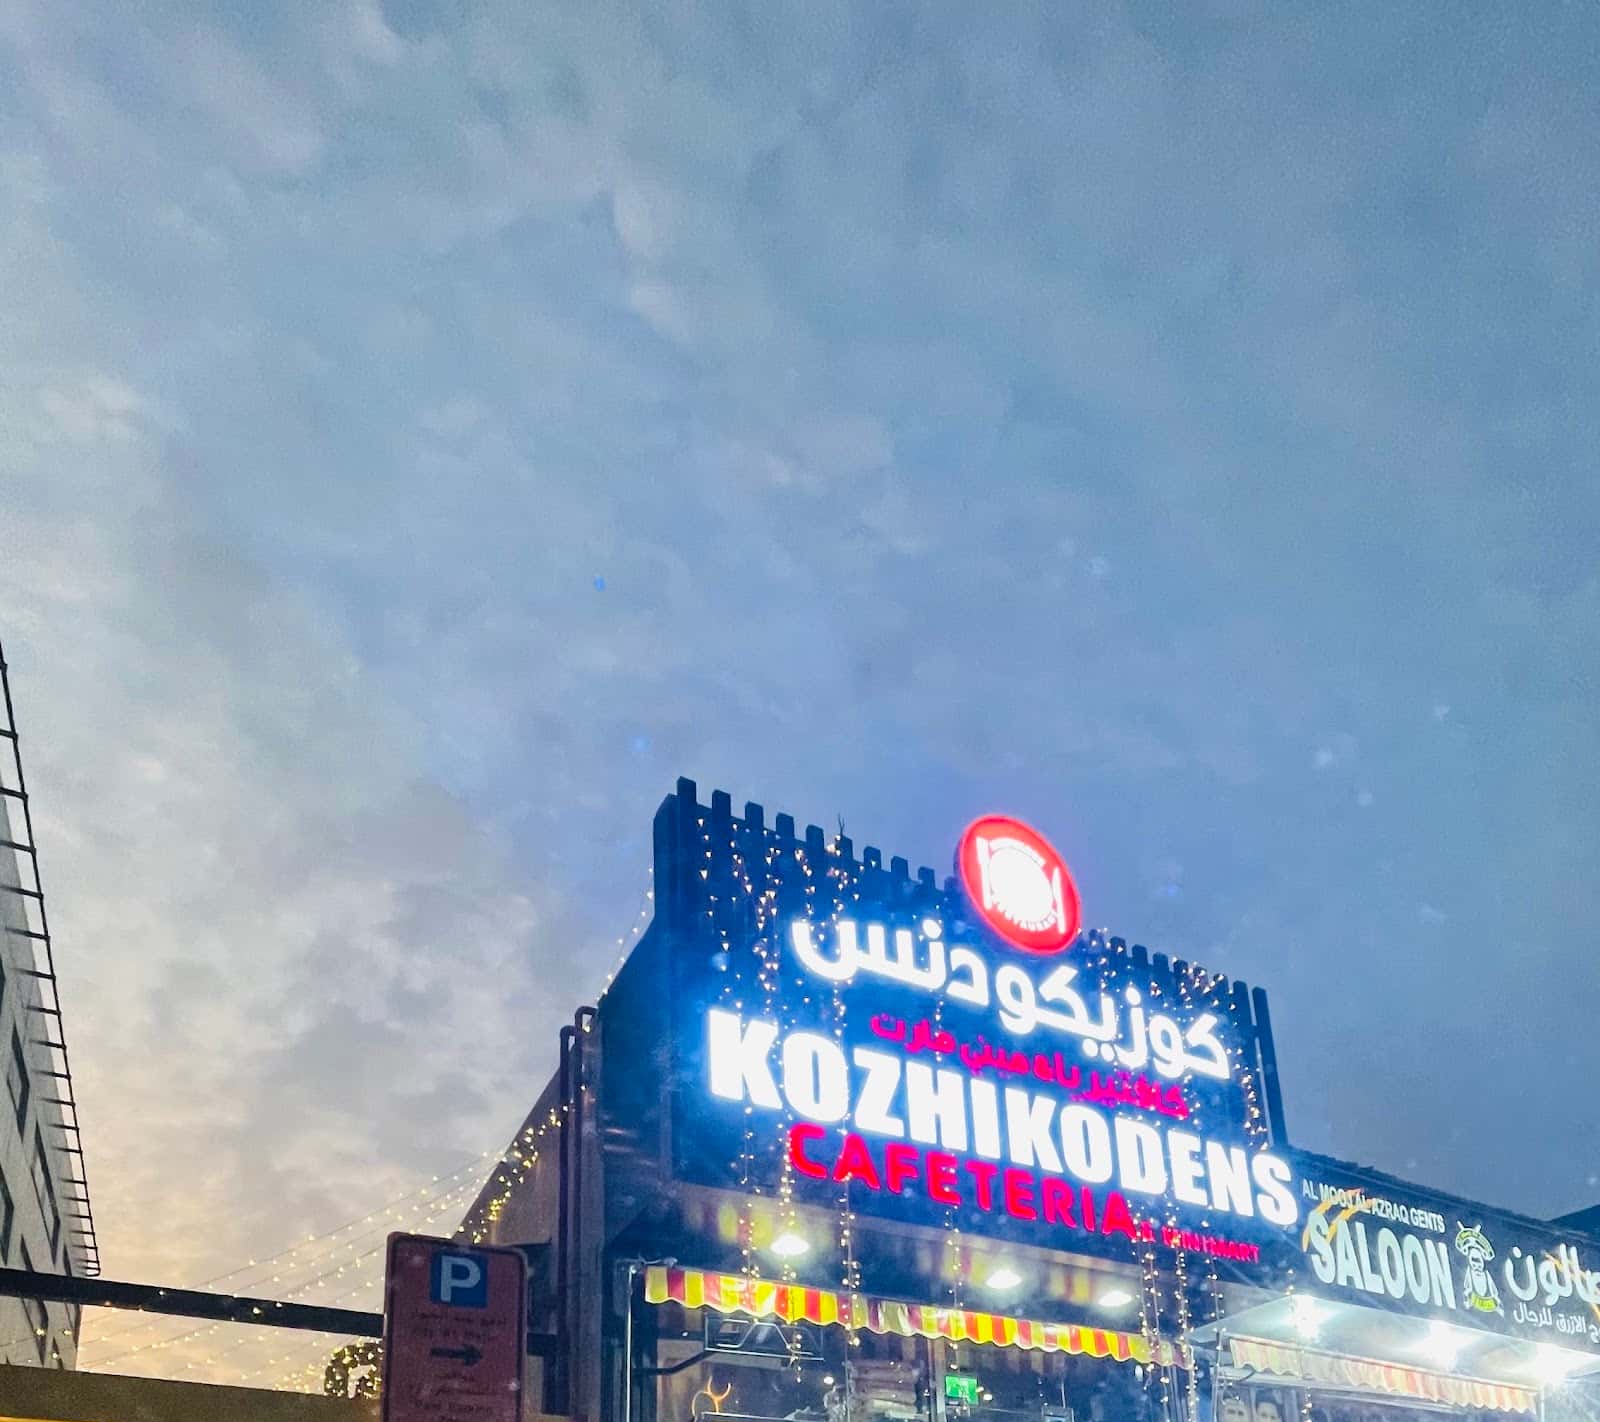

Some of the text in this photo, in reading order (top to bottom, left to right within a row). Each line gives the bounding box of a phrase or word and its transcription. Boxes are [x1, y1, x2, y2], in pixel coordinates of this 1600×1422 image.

[707, 1008, 1299, 1228] KOZHIKODENS
[788, 1122, 1139, 1240] CAFETERIA
[1302, 1178, 1319, 1201] AL
[1371, 1198, 1410, 1226] AZRAQ
[1410, 1207, 1446, 1234] GENTS
[440, 1255, 481, 1303] P
[1309, 1209, 1457, 1310] SALOON
